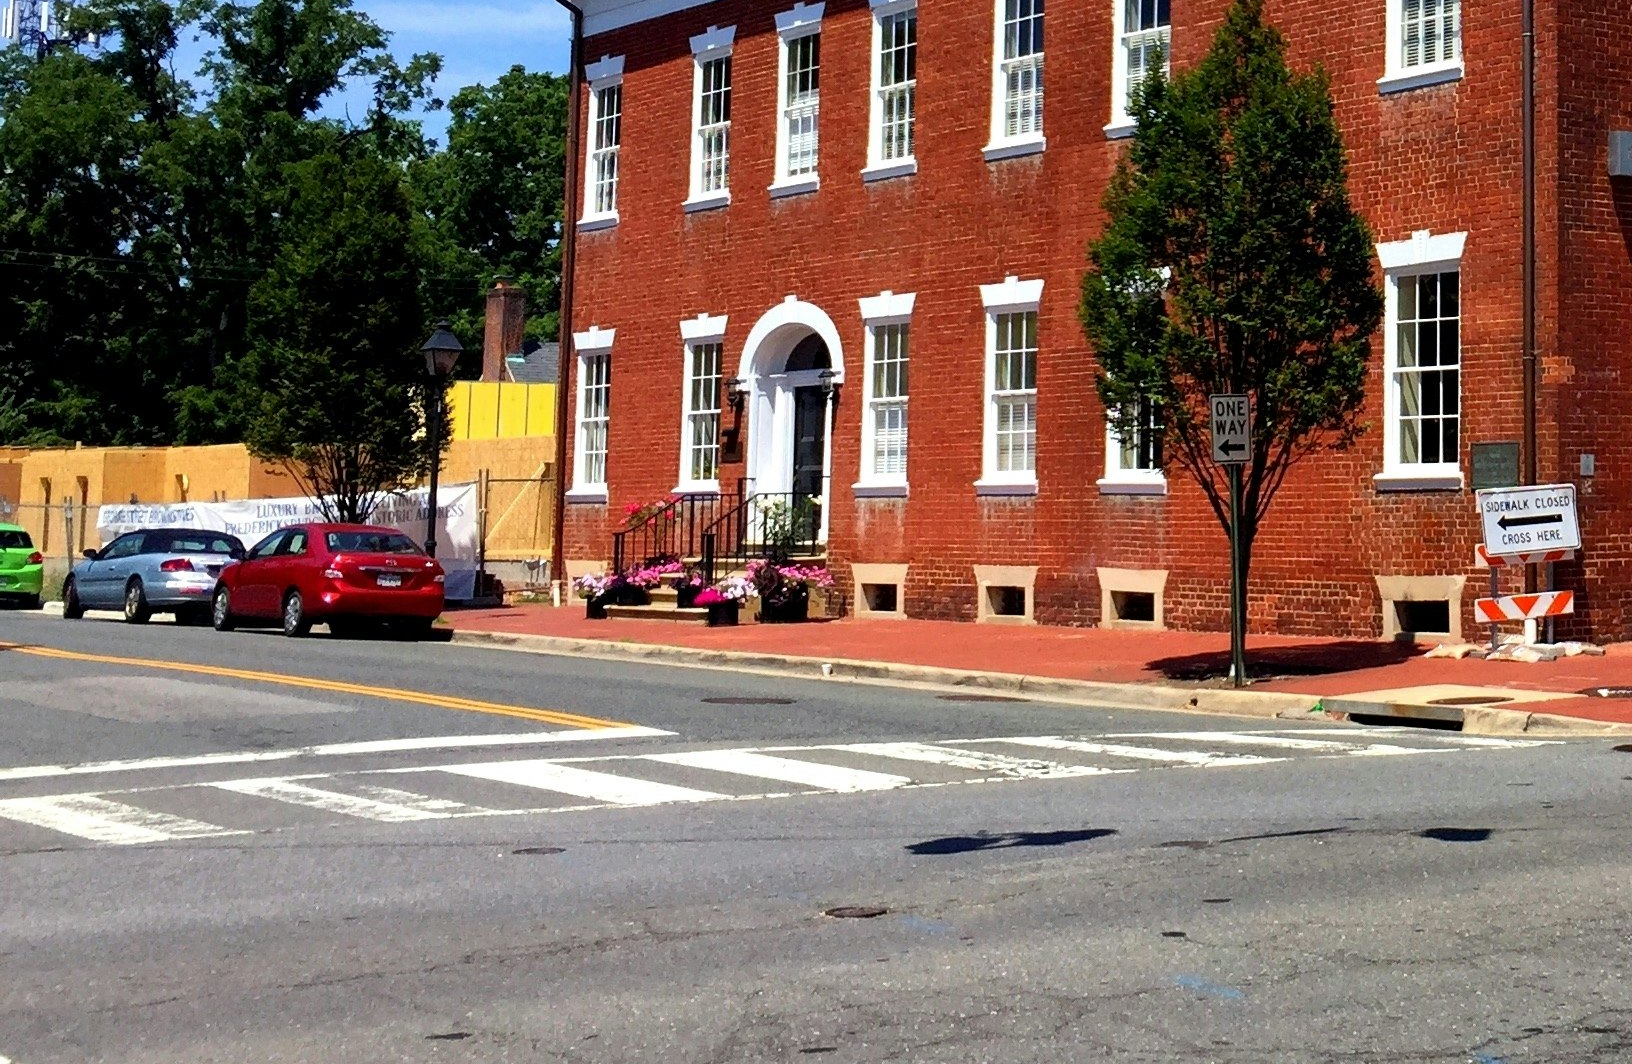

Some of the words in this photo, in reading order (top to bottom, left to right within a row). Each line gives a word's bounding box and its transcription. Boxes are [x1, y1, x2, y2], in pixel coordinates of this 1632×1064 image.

[1215, 401, 1245, 417] ONE
[1215, 419, 1247, 435] WAY
[257, 503, 297, 518] LUXURY
[1485, 499, 1530, 513] SIDEWALK
[1535, 495, 1570, 509] CLOSED
[375, 508, 413, 524] STORIC
[415, 503, 464, 521] ADRESS
[1502, 531, 1532, 545] CROSS
[1537, 529, 1562, 541] HERE
